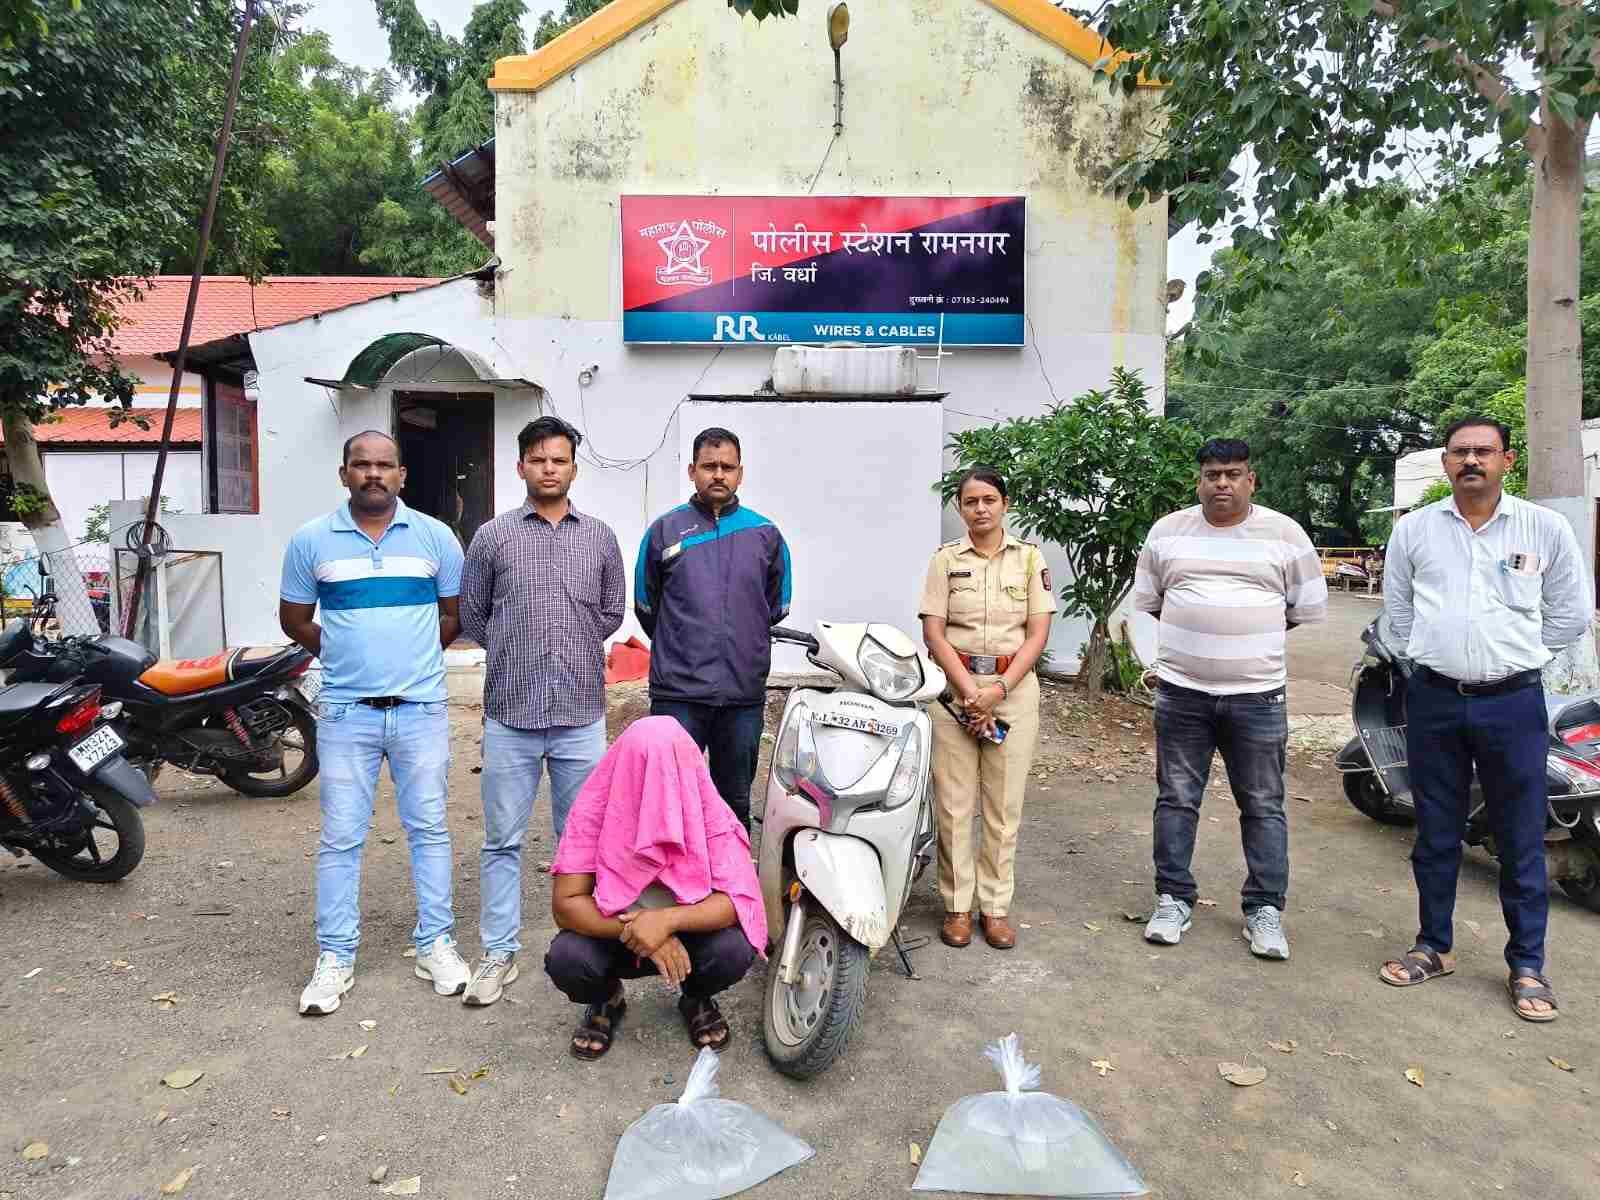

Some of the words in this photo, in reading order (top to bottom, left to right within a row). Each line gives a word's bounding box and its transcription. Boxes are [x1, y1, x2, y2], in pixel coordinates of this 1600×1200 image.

[750, 223, 832, 254] पोलीस
[839, 223, 913, 256] स्टेशन
[919, 232, 1011, 255] रामनगर
[749, 261, 777, 283] जि.
[782, 261, 818, 283] वर्धा
[713, 315, 766, 341] RR
[814, 324, 862, 337] WIRES
[865, 325, 875, 337] &
[878, 325, 936, 337] CABLES
